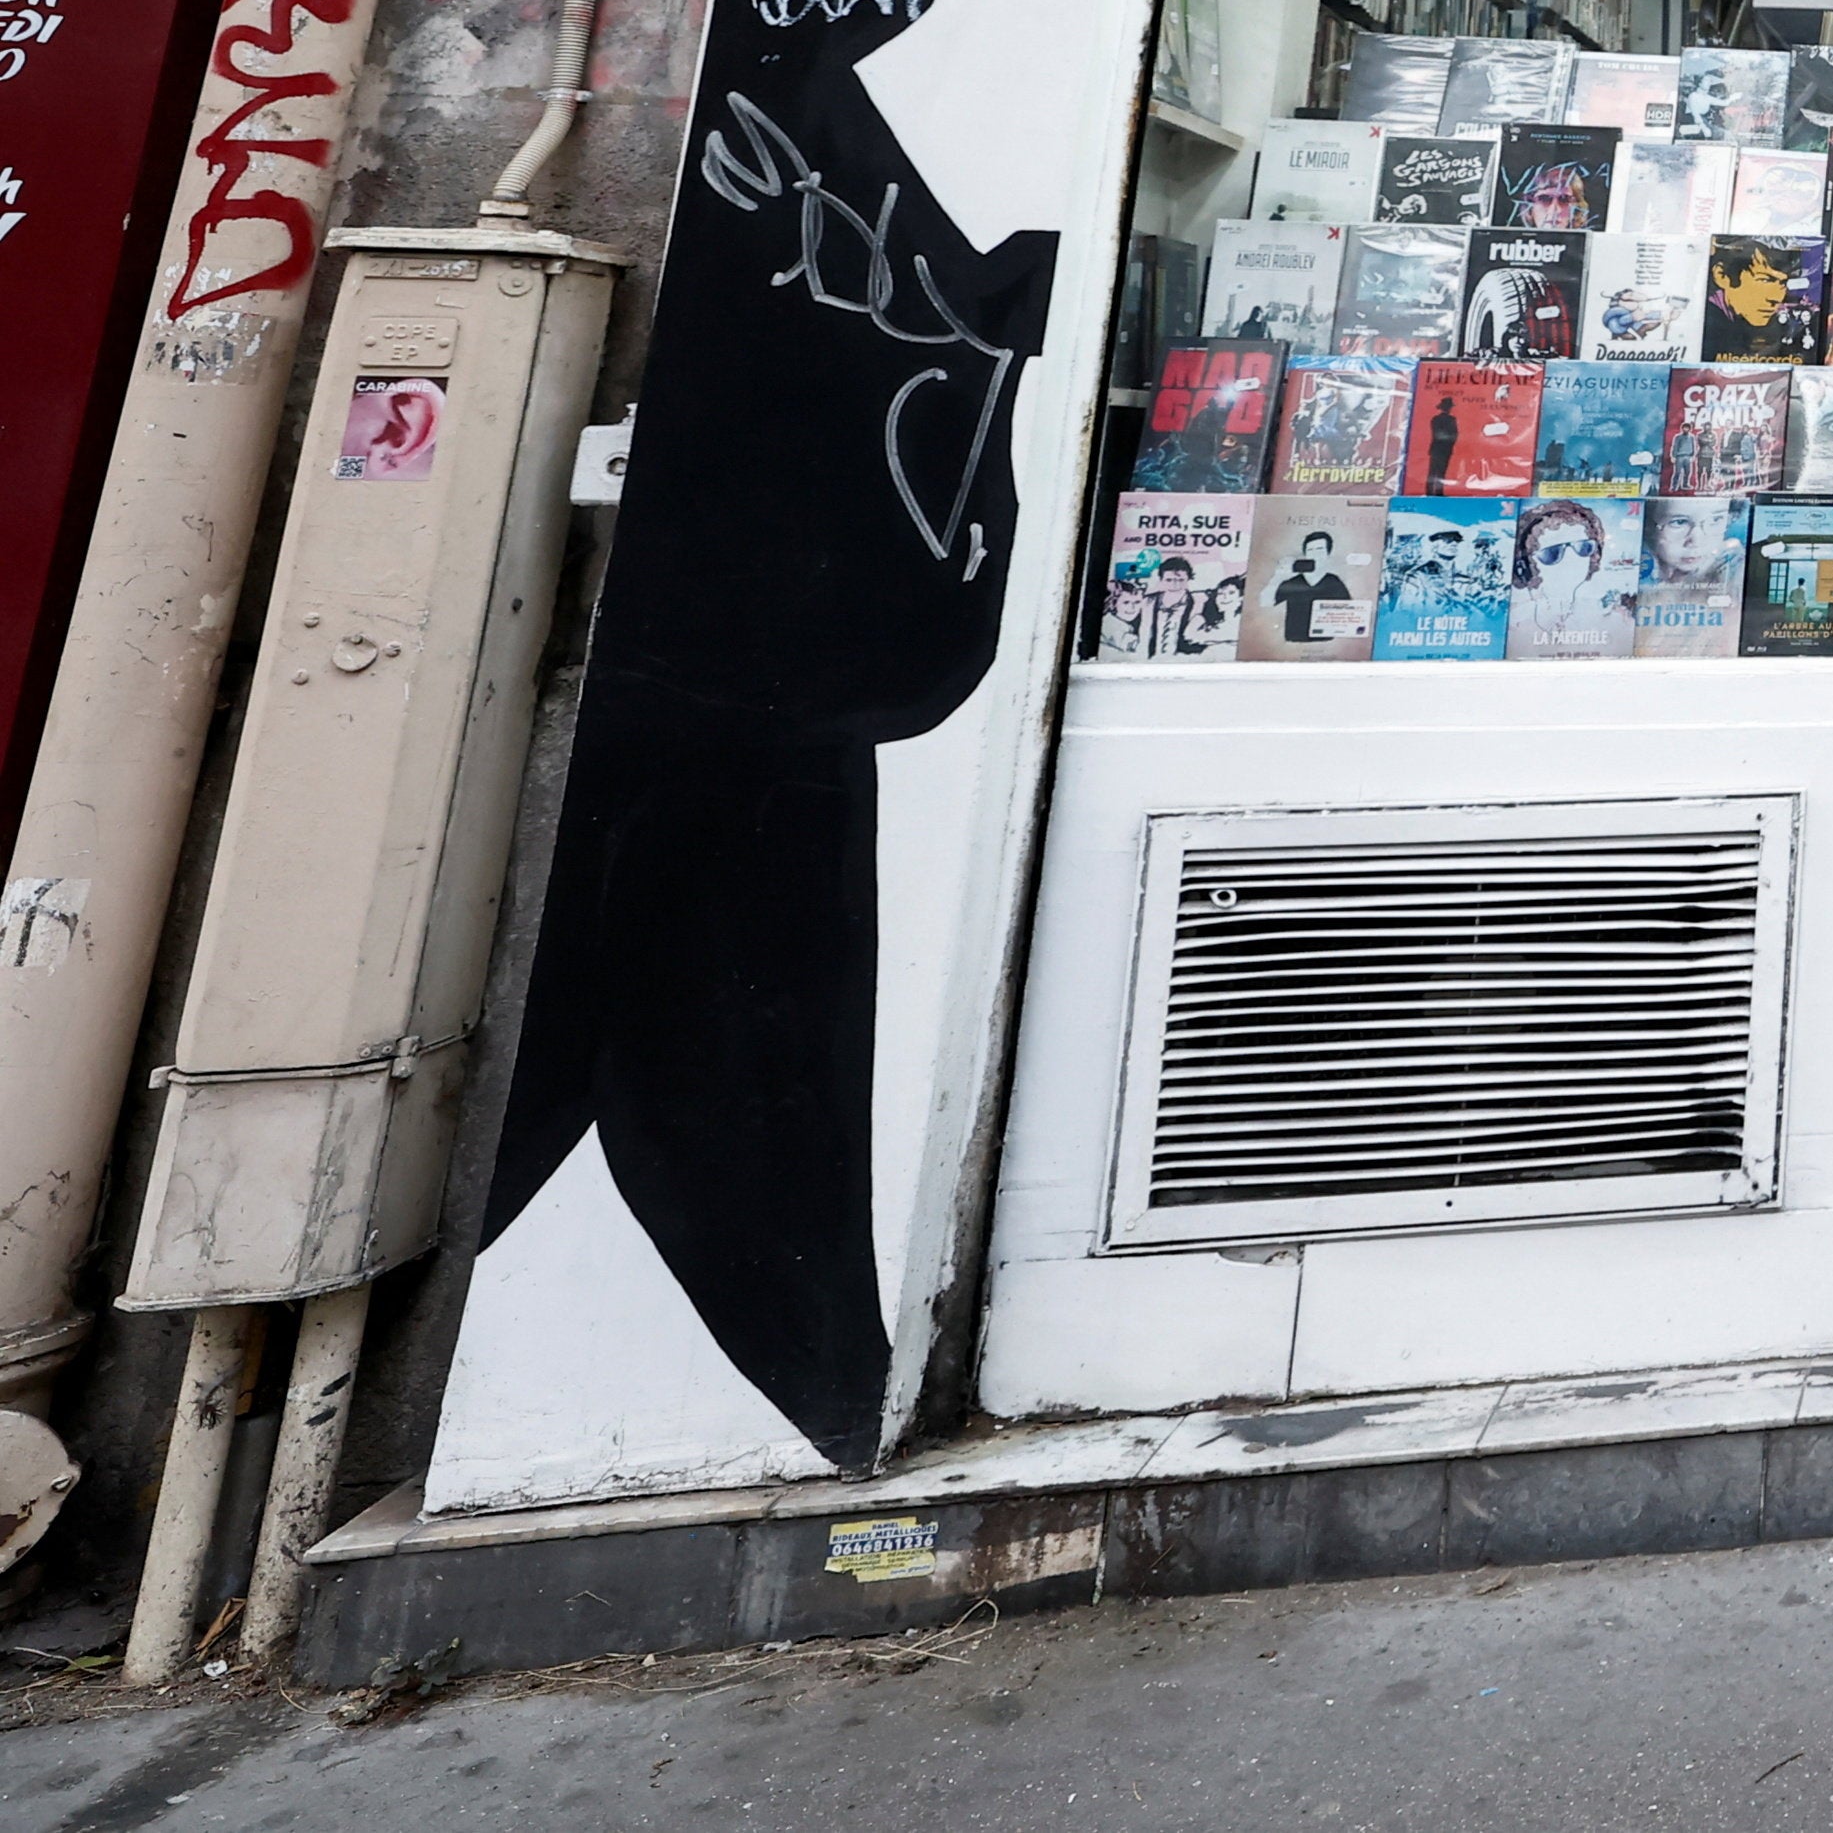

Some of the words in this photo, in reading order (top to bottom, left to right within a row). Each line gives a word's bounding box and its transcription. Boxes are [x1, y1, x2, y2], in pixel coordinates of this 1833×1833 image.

[1290, 150, 1304, 167] LE
[1305, 150, 1349, 169] MIROIR
[1489, 238, 1567, 264] rubber
[1159, 348, 1274, 392] MAD
[356, 380, 433, 394] CARABINE
[1543, 375, 1670, 391] ZVIAGUINTSEV
[1683, 382, 1772, 407] CRAZY
[1683, 406, 1775, 431] FAMILY
[1138, 515, 1189, 531] RITA,
[1192, 515, 1231, 529] SUE
[1636, 605, 1723, 628] Gloria
[1389, 631, 1424, 646] PARMI
[1425, 631, 1448, 646] LES
[1449, 631, 1492, 647] AUTRES
[832, 1535, 934, 1557] 0646841236
